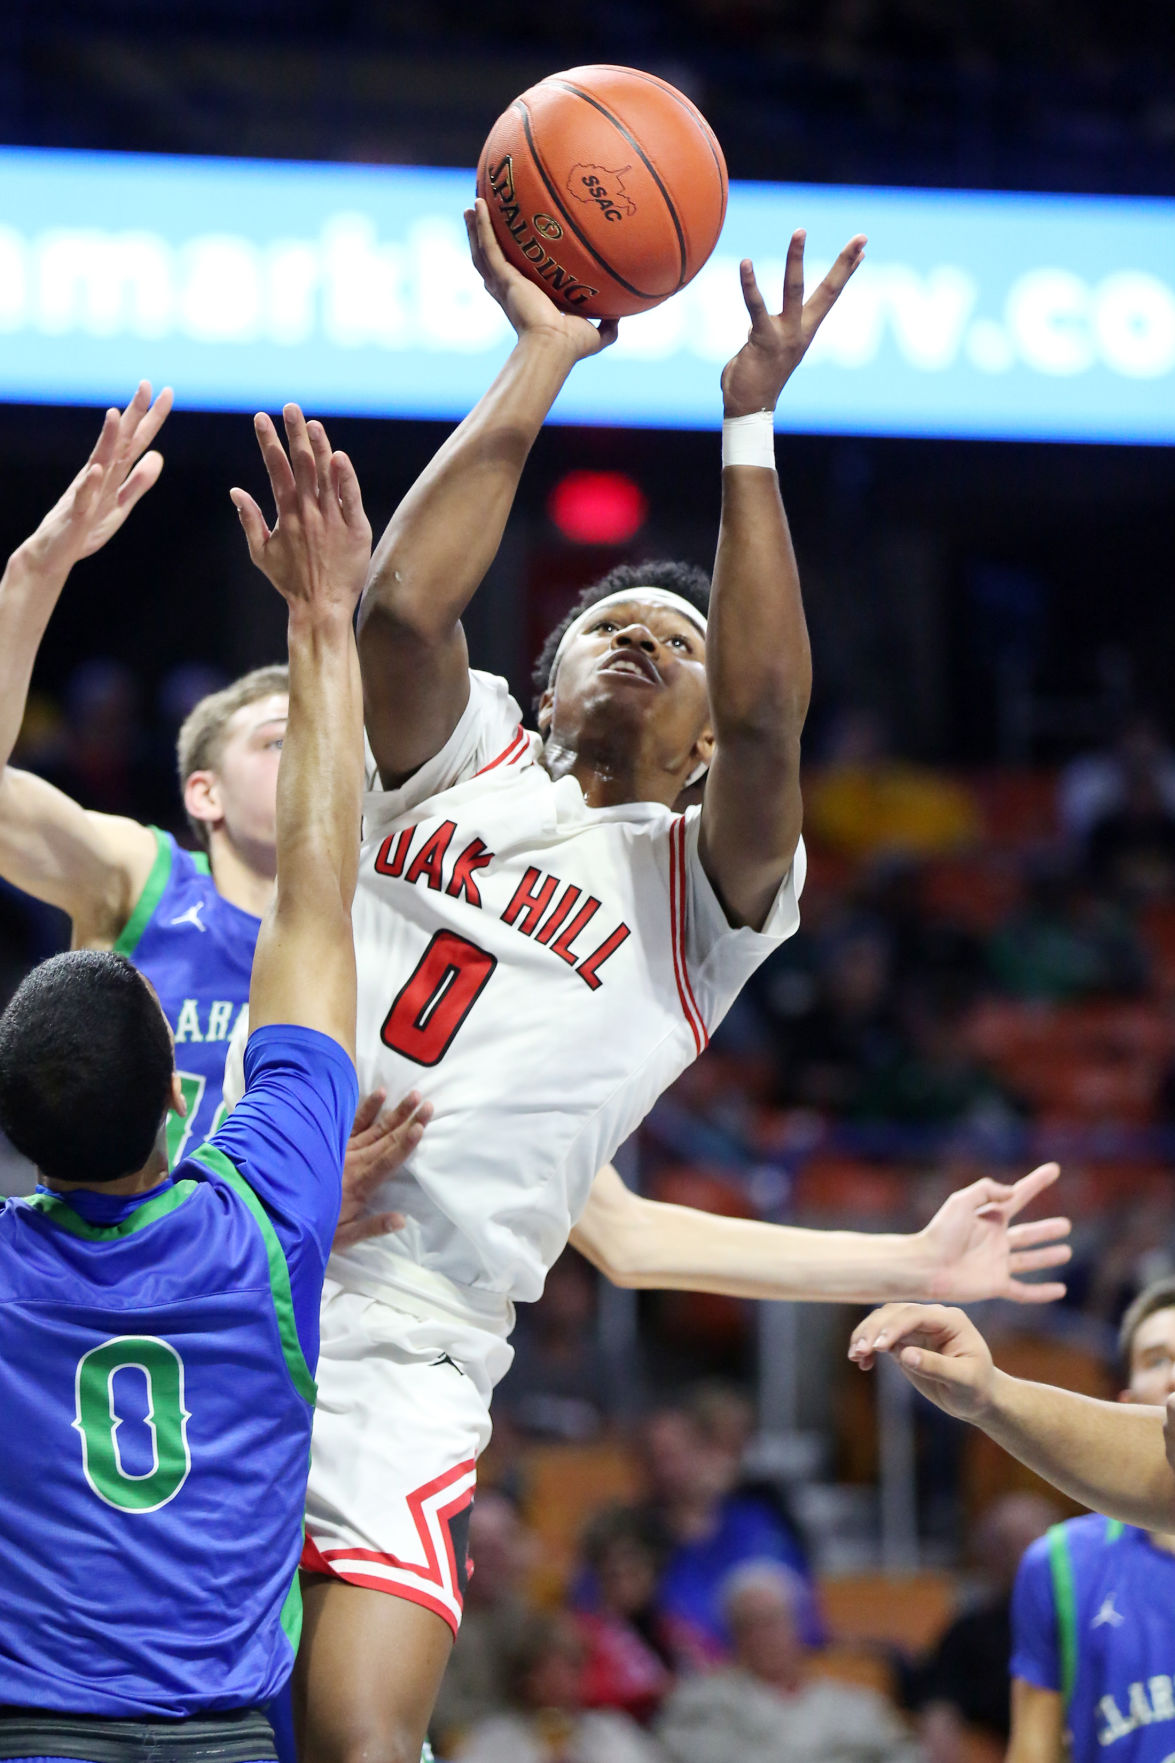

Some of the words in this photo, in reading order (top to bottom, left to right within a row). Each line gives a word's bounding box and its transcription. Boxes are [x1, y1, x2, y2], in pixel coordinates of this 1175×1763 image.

[488, 154, 599, 306] SPALDING
[582, 175, 622, 222] SSAC
[380, 928, 498, 1068] 0
[500, 865, 632, 992] HILL
[71, 1334, 192, 1514] 0
